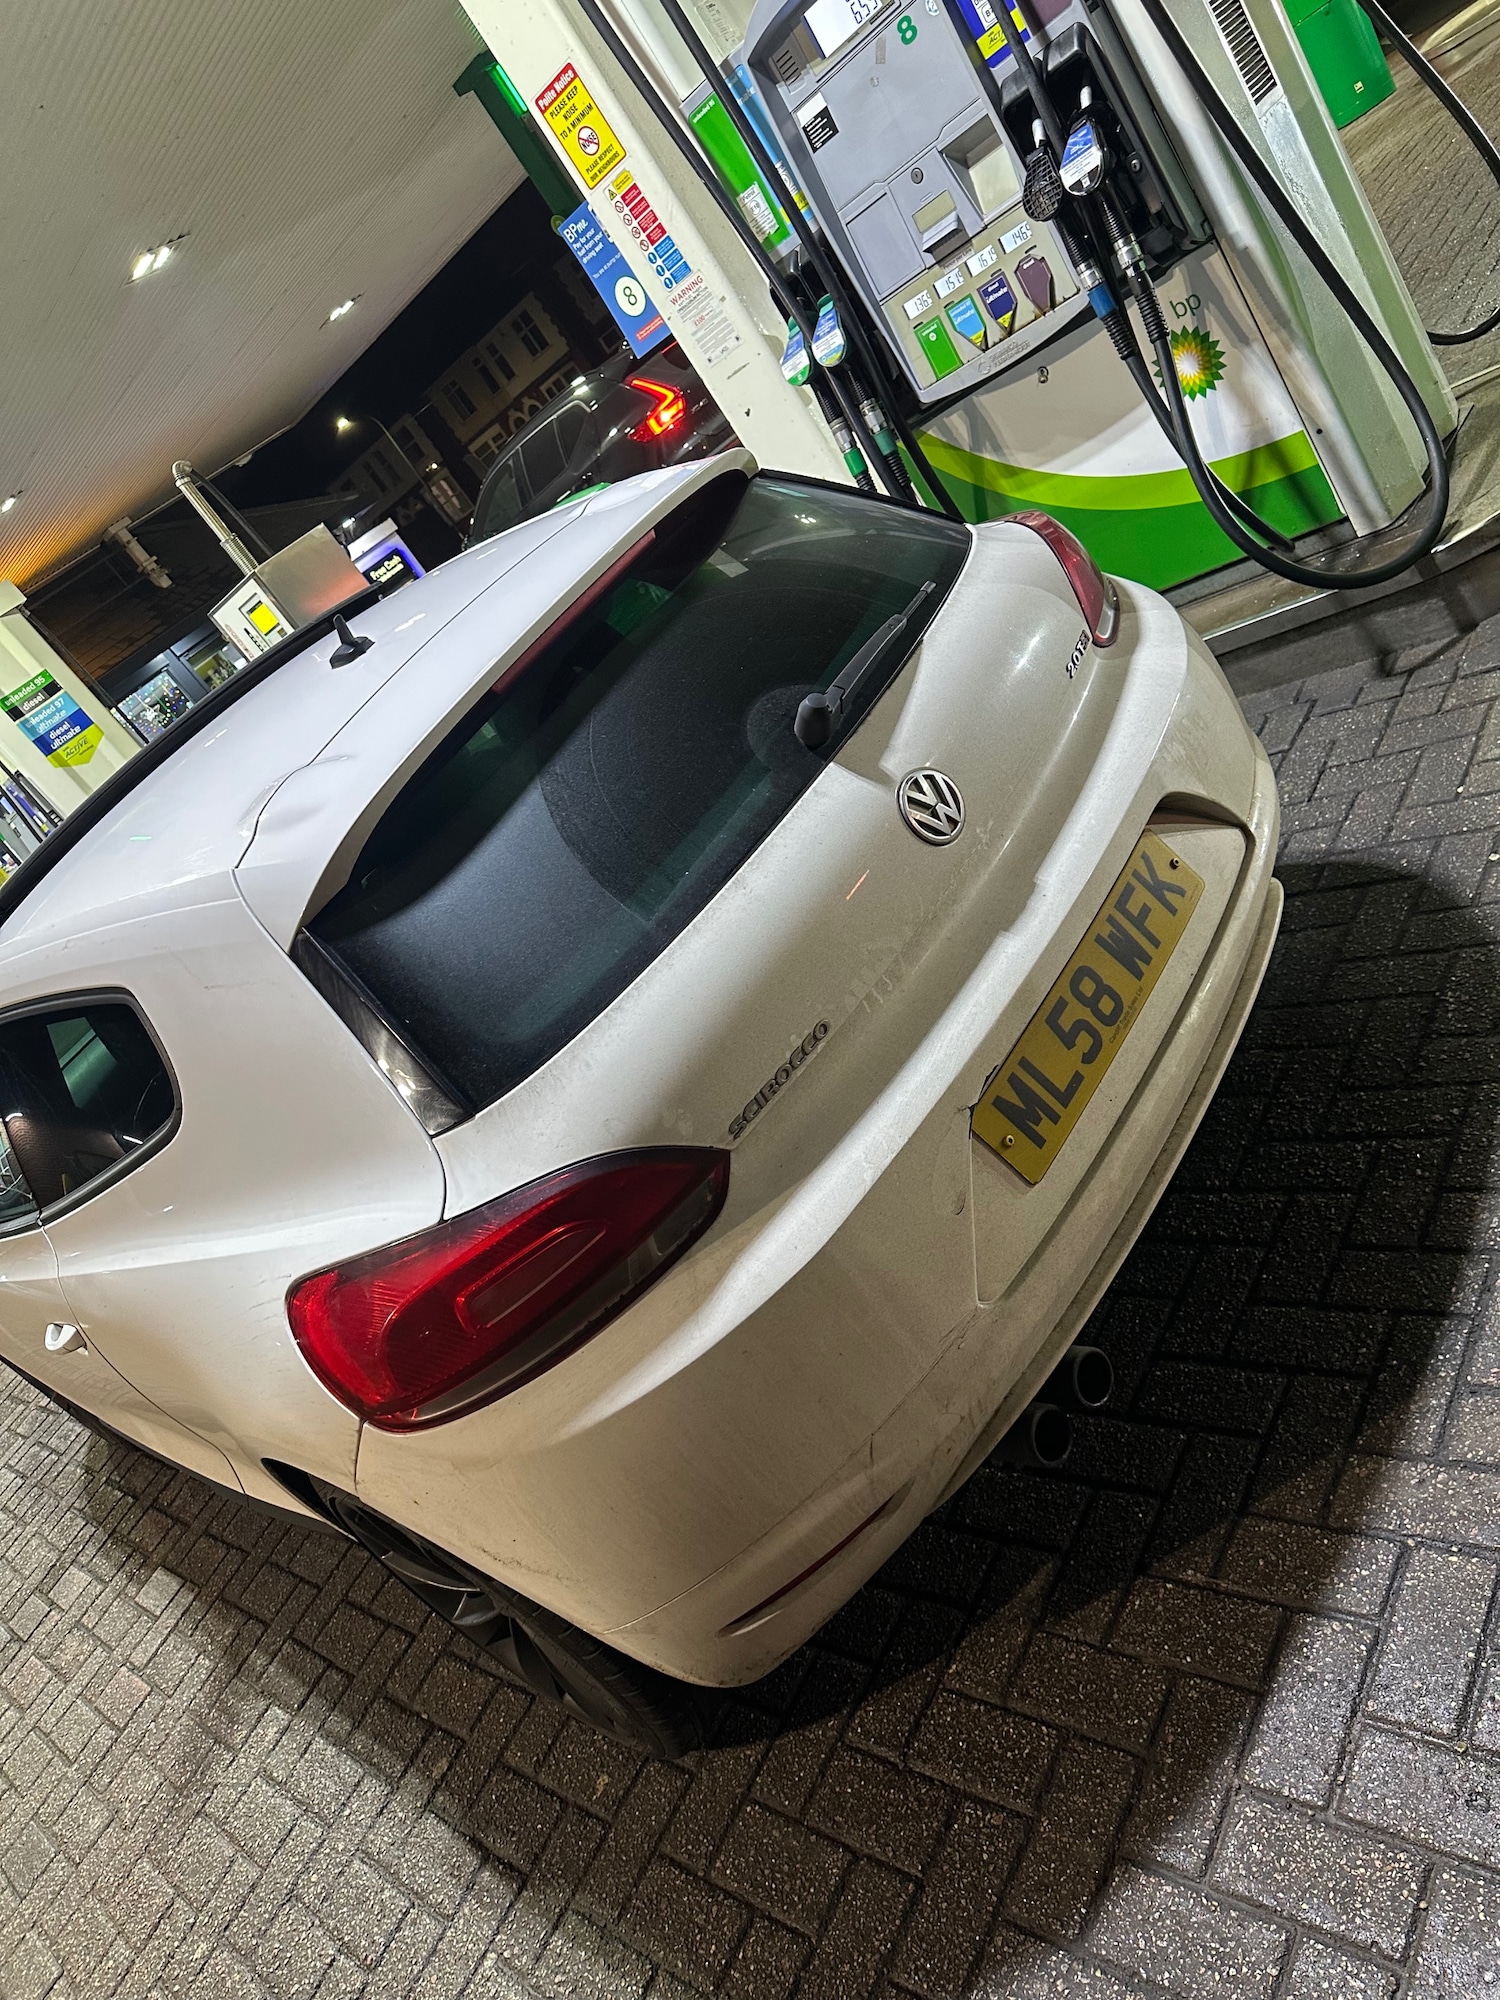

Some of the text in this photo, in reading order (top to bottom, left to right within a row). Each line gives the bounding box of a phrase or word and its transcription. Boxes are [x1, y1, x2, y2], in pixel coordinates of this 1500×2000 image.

[897, 15, 918, 45] 8
[538, 69, 574, 110] Polite Notice
[549, 85, 579, 119] PLEASE KEEP
[560, 131, 568, 140] TO
[570, 102, 594, 129] MINIMUM
[563, 103, 578, 122] NOISE
[586, 143, 615, 174] PLEASE RESPECT
[590, 172, 598, 182] OUR
[598, 151, 620, 175] NEIGHBOURS
[572, 228, 595, 251] Pay for your
[582, 242, 604, 264] driving seat
[584, 239, 595, 251] from
[593, 231, 603, 243] your
[623, 286, 638, 306] 8
[670, 275, 704, 306] WARNING
[1169, 294, 1201, 319] bp
[5, 675, 46, 706] unleaded 95
[23, 692, 45, 711] diesel
[25, 697, 65, 728] unleaded 97
[36, 709, 67, 734] ultimate
[49, 721, 71, 740] diesel
[50, 725, 82, 750] ultimate
[65, 736, 89, 758] ACTIVE
[991, 851, 1187, 1150] ML58 WFK
[728, 1018, 831, 1141] SCIROCCO
